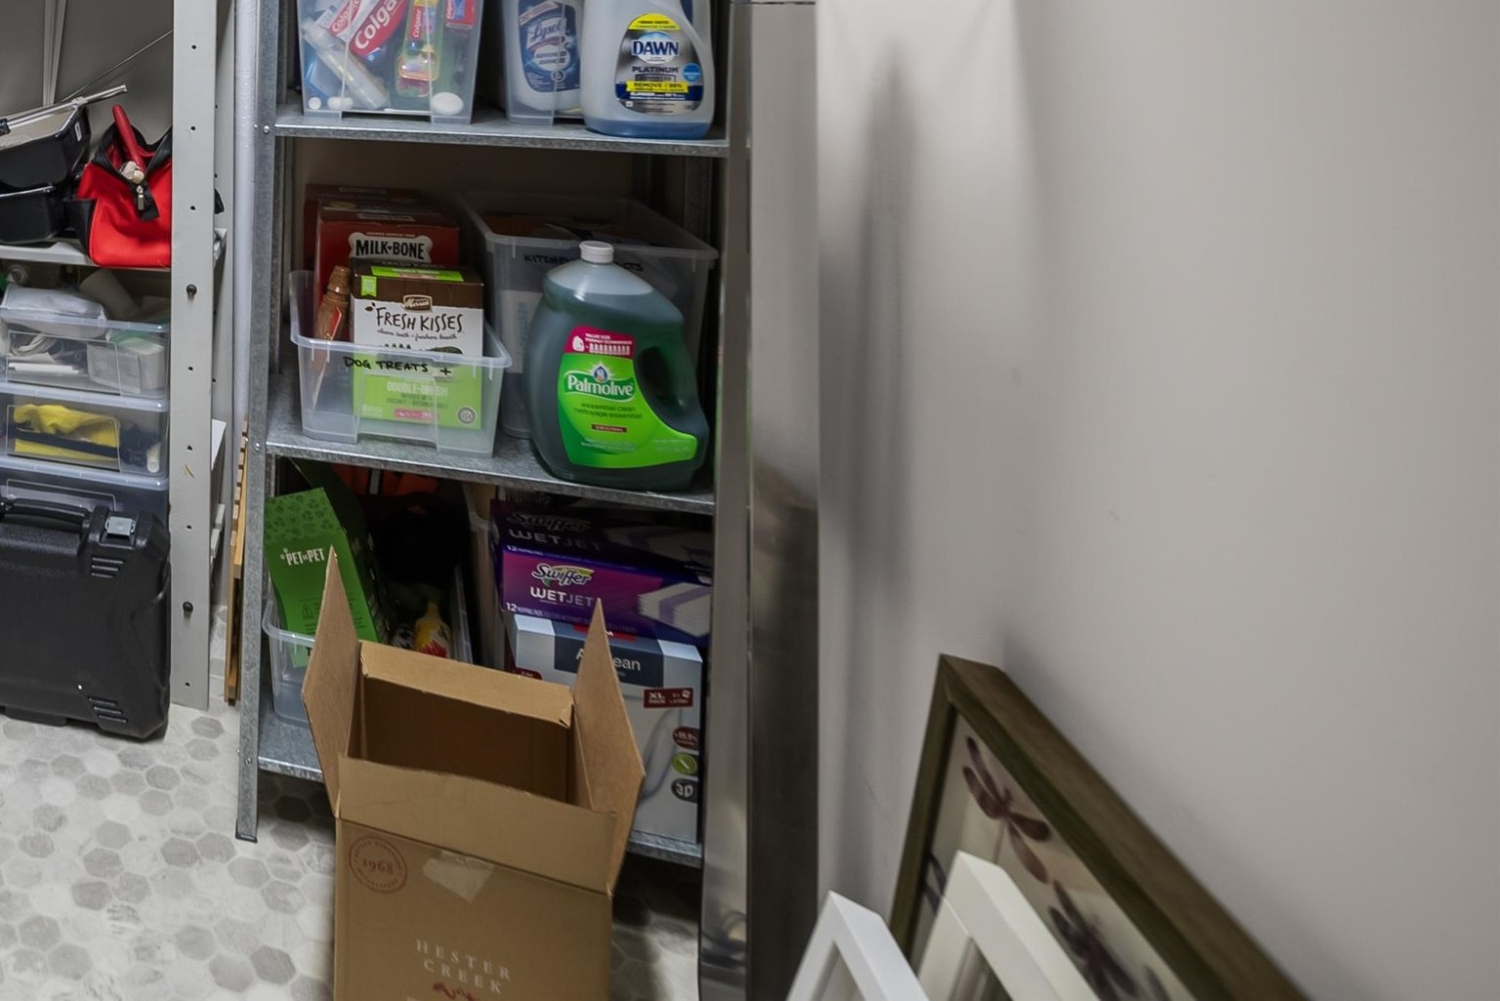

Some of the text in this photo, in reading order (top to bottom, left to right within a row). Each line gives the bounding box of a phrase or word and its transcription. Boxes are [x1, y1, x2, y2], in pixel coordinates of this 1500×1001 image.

[413, 9, 422, 38] Colgate
[531, 22, 561, 40] Lysol
[632, 40, 679, 56] DAWN
[375, 307, 464, 334] FRESH KISSES
[342, 356, 371, 370] DOG
[376, 360, 429, 373] TREATS
[567, 374, 633, 397] Palmolive
[574, 408, 608, 417] nettoyage
[581, 402, 616, 410] essential
[286, 547, 325, 567] PET PET
[531, 562, 593, 587] Swiffer
[530, 585, 594, 608] WETJET
[505, 601, 517, 612] 12
[648, 691, 665, 699] XL
[675, 783, 694, 797] 3D
[362, 857, 395, 876] 1968
[415, 938, 512, 981] HESTER
[423, 959, 503, 994] CREEK
